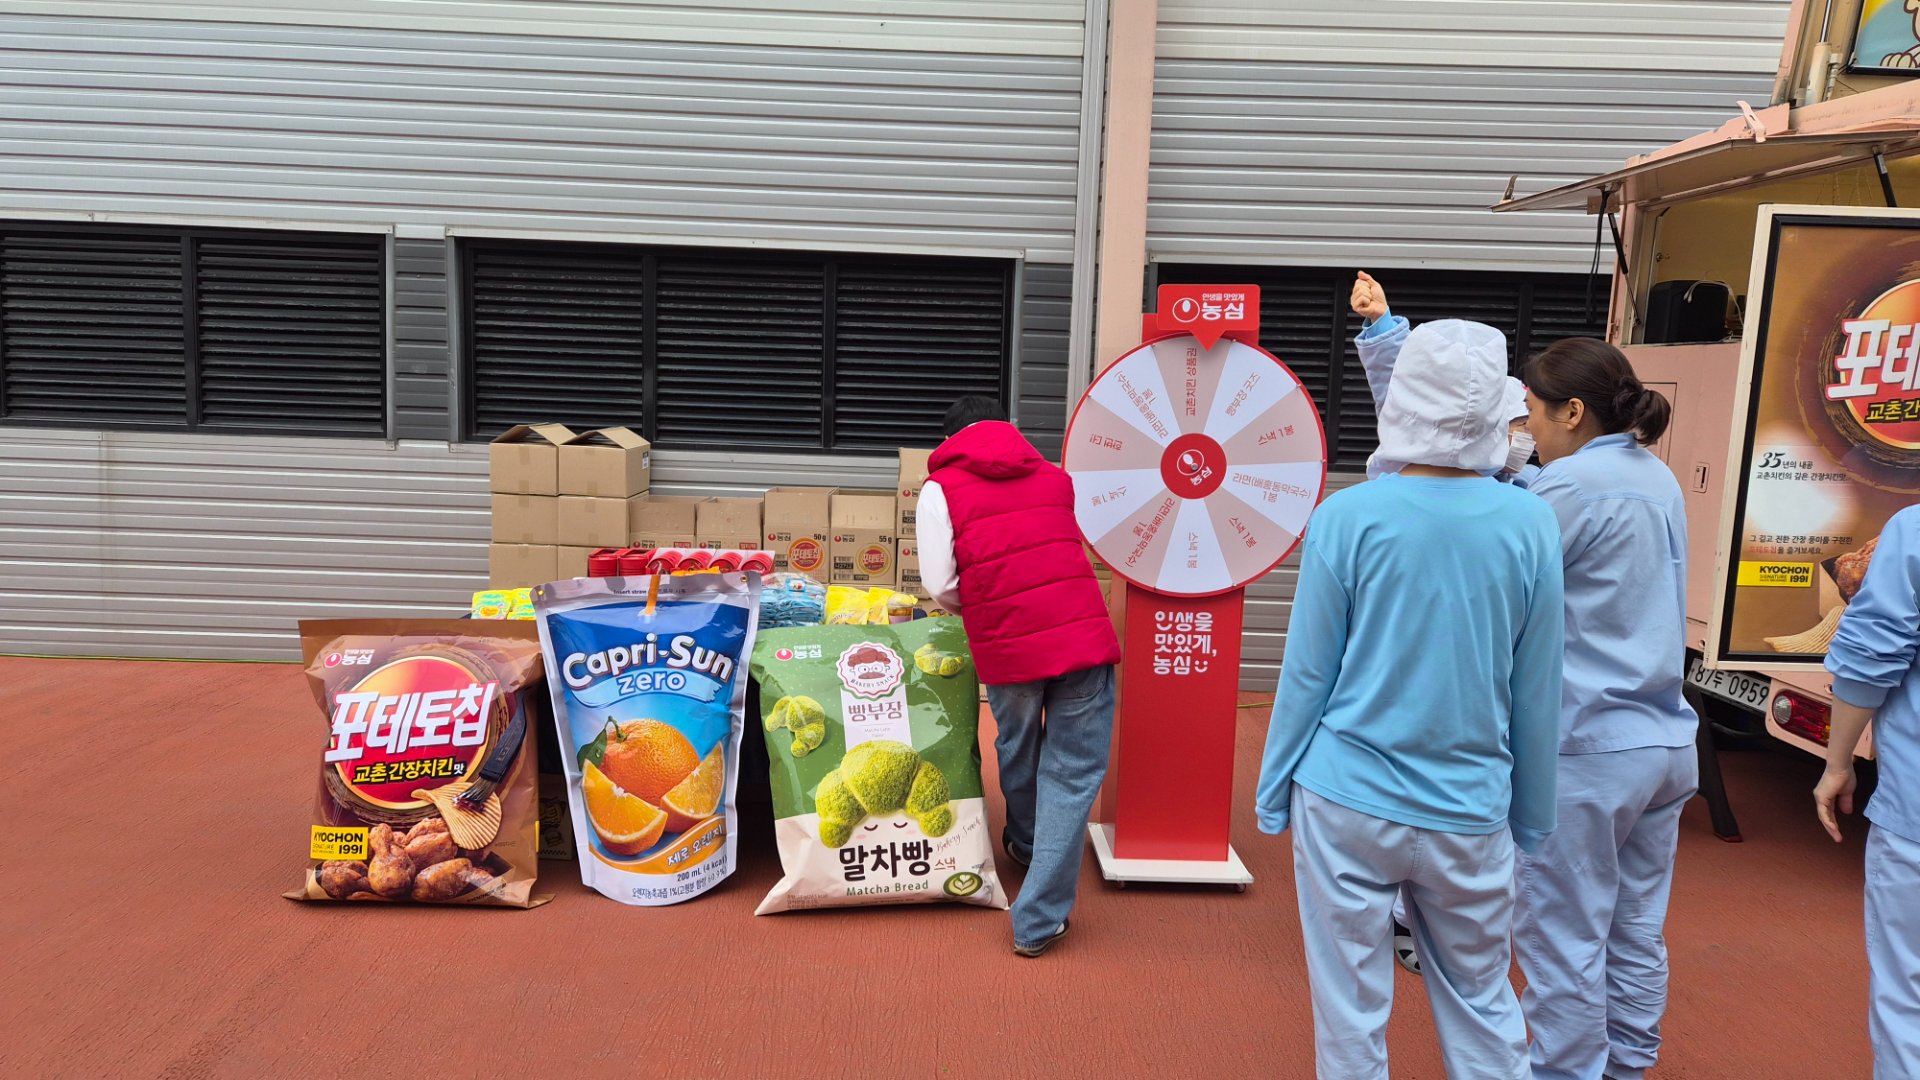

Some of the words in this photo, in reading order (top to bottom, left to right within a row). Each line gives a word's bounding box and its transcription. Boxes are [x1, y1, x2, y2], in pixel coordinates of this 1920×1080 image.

[1201, 302, 1244, 320] 농심
[1186, 347, 1197, 378] 상품권
[1186, 379, 1197, 416] 교촌치킨
[1866, 401, 1901, 420] 교촌
[1104, 438, 1123, 451] 한번
[1257, 431, 1277, 446] 스낵
[1279, 425, 1295, 438] 1봉
[1758, 452, 1797, 469] 35년의
[1190, 466, 1212, 486] 농심
[1757, 472, 1792, 480] 교촌치킨의
[1109, 486, 1127, 501] 스낵
[813, 533, 821, 541] 50
[879, 535, 887, 543] 55
[1187, 532, 1198, 552] 스낵
[1229, 516, 1246, 534] 스낵
[1244, 533, 1257, 549] 1봉
[1776, 535, 1790, 544] 진한
[1792, 536, 1806, 544] 간장
[1808, 536, 1829, 544] 풍미를
[1187, 553, 1198, 569] 1봉
[1760, 566, 1809, 574] KYOCHON
[1155, 611, 1213, 632] 인생을
[794, 648, 822, 659] 농심
[1155, 634, 1217, 657] 맛있게,
[341, 654, 373, 665] 농심
[563, 633, 734, 689] Capri-Sun
[1153, 655, 1191, 675] 농심
[618, 671, 686, 695] zero
[1728, 676, 1770, 706] 0959
[848, 701, 902, 722] 빵부장
[324, 681, 497, 763] 포테토칩
[353, 763, 387, 782] 교촌
[314, 831, 363, 842] KYOCHON
[667, 847, 690, 866] 제로
[692, 824, 722, 854] 오렌지
[339, 845, 362, 854] 1991
[677, 871, 690, 882] 200
[691, 868, 702, 877] mL
[711, 854, 728, 868] kcal)
[839, 839, 933, 881] 말차빵
[934, 857, 956, 871] 스낵
[846, 884, 890, 896] Matcha
[895, 880, 929, 892] Bread
